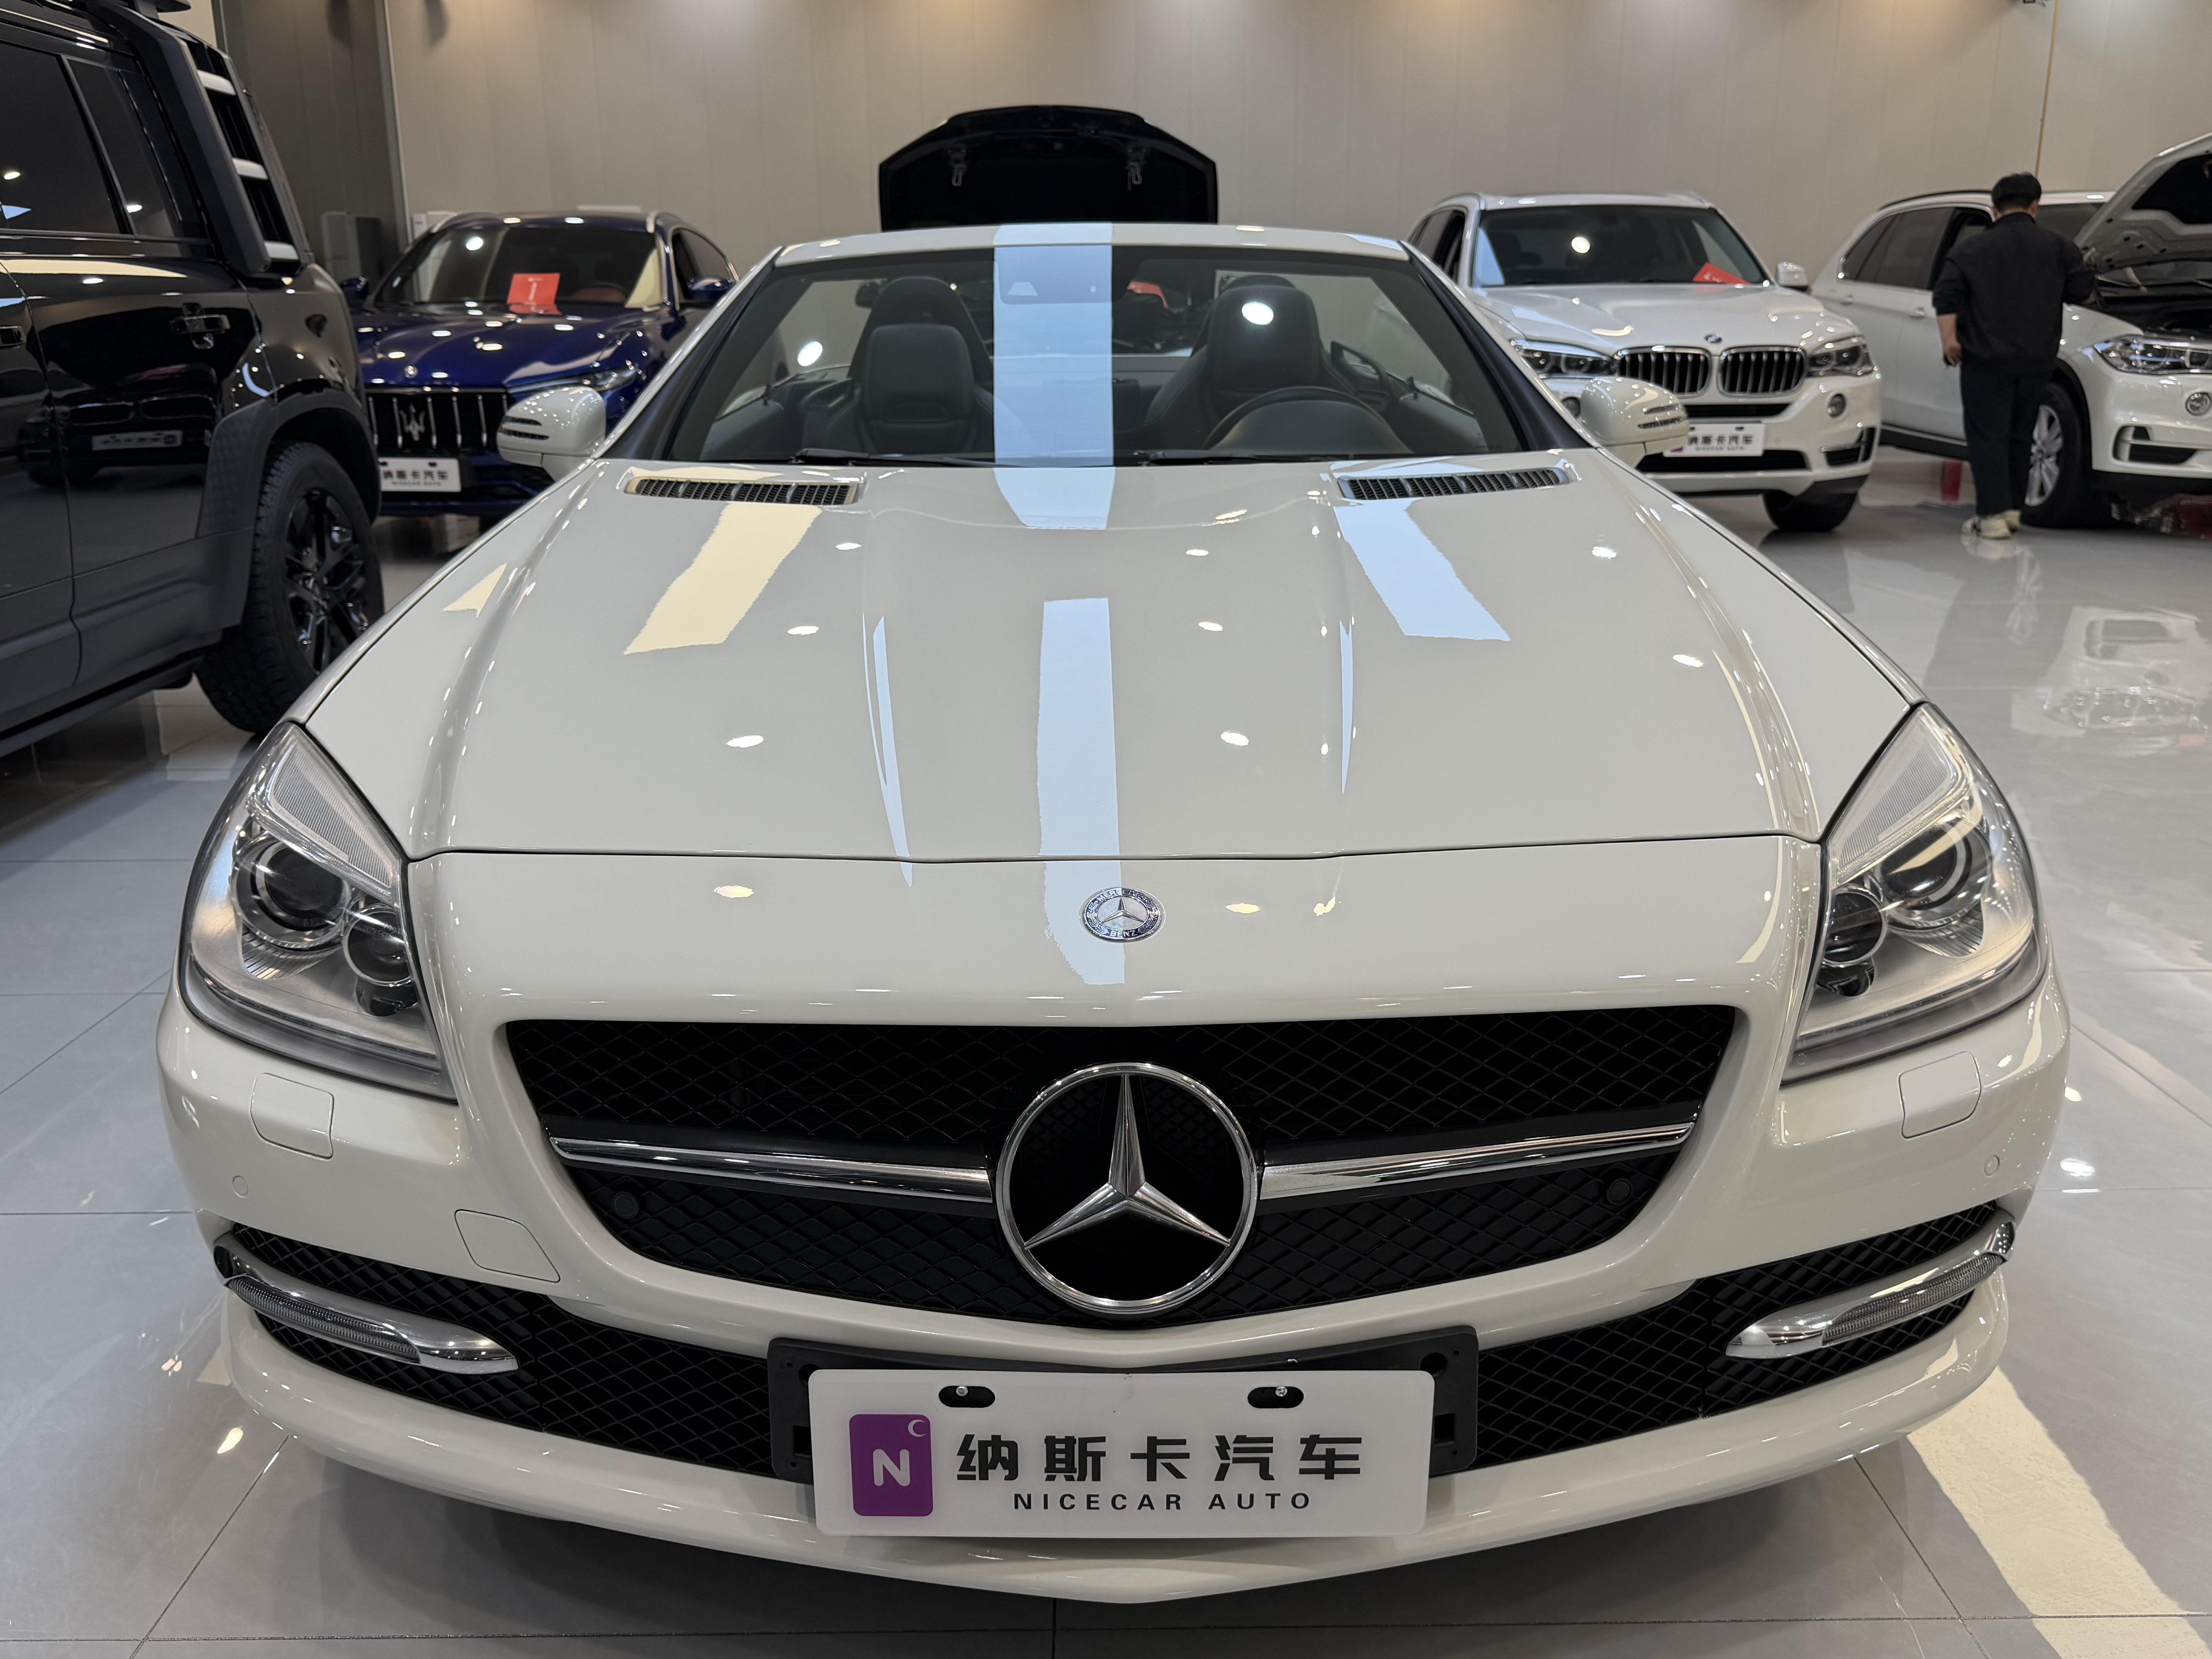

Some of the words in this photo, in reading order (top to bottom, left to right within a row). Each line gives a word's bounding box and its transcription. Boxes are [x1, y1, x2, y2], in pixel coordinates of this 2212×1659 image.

[873, 1449, 910, 1486] N
[957, 1434, 1362, 1482] 纳斯卡汽车
[1014, 1493, 1182, 1510] NICECAR
[1208, 1492, 1311, 1510] AUTO
